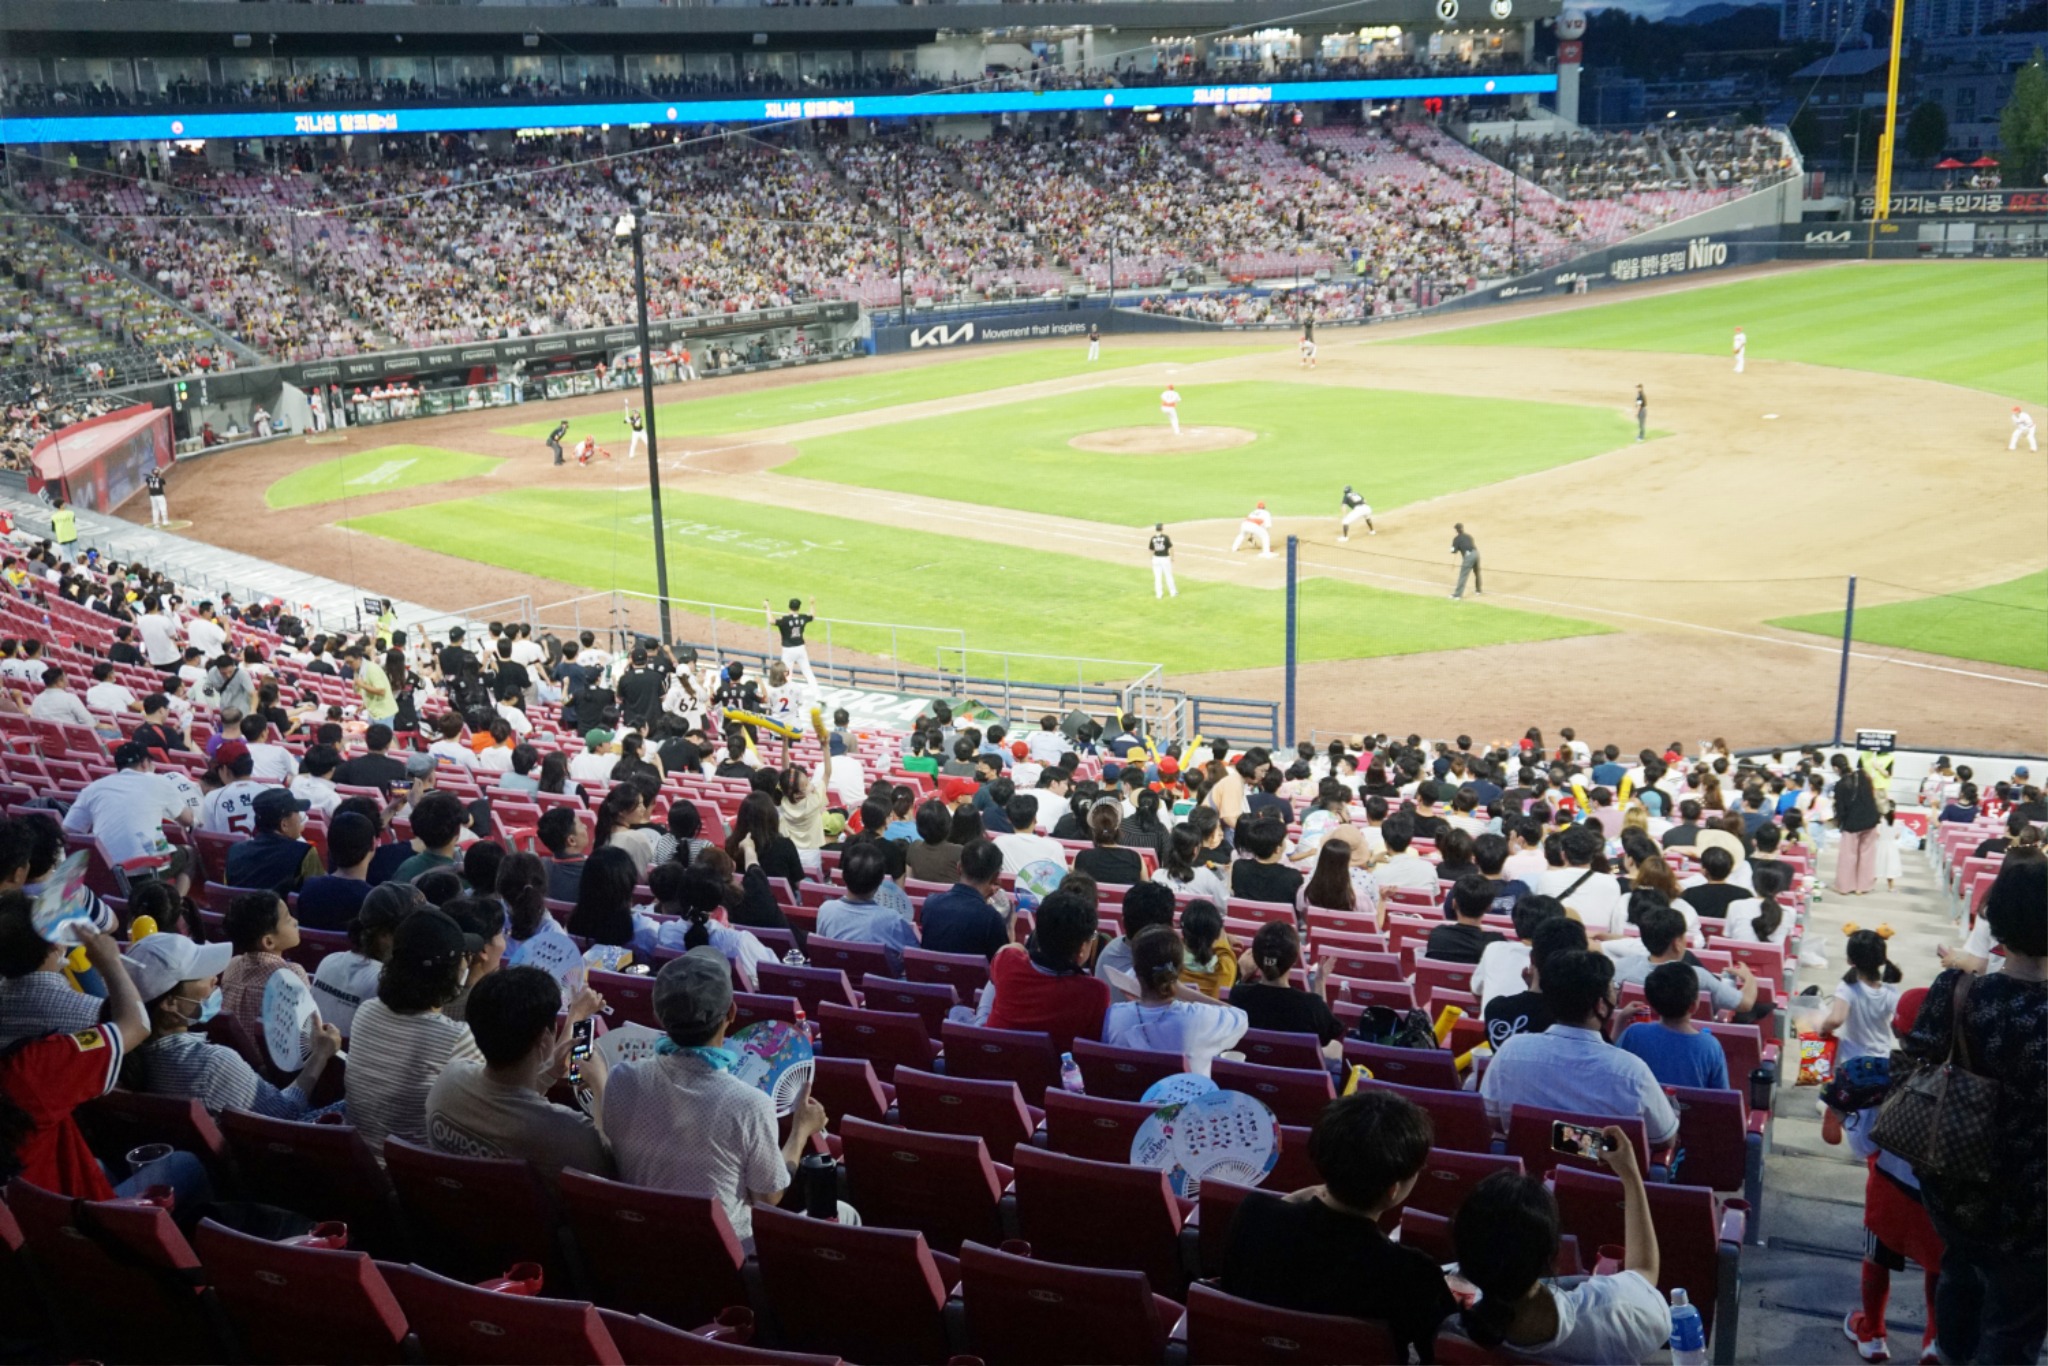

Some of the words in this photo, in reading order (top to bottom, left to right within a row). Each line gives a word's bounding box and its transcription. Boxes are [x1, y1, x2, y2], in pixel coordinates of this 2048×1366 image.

[1860, 196, 1937, 213] 유기기는
[1688, 236, 1728, 270] Niro
[982, 324, 1030, 340] Movement
[1032, 323, 1050, 335] that
[1052, 321, 1087, 335] inspires
[679, 698, 698, 712] 62
[778, 697, 789, 712] 2
[228, 814, 257, 838] 5
[314, 979, 361, 1005] HUMMER
[432, 1121, 498, 1158] OUTDOO
